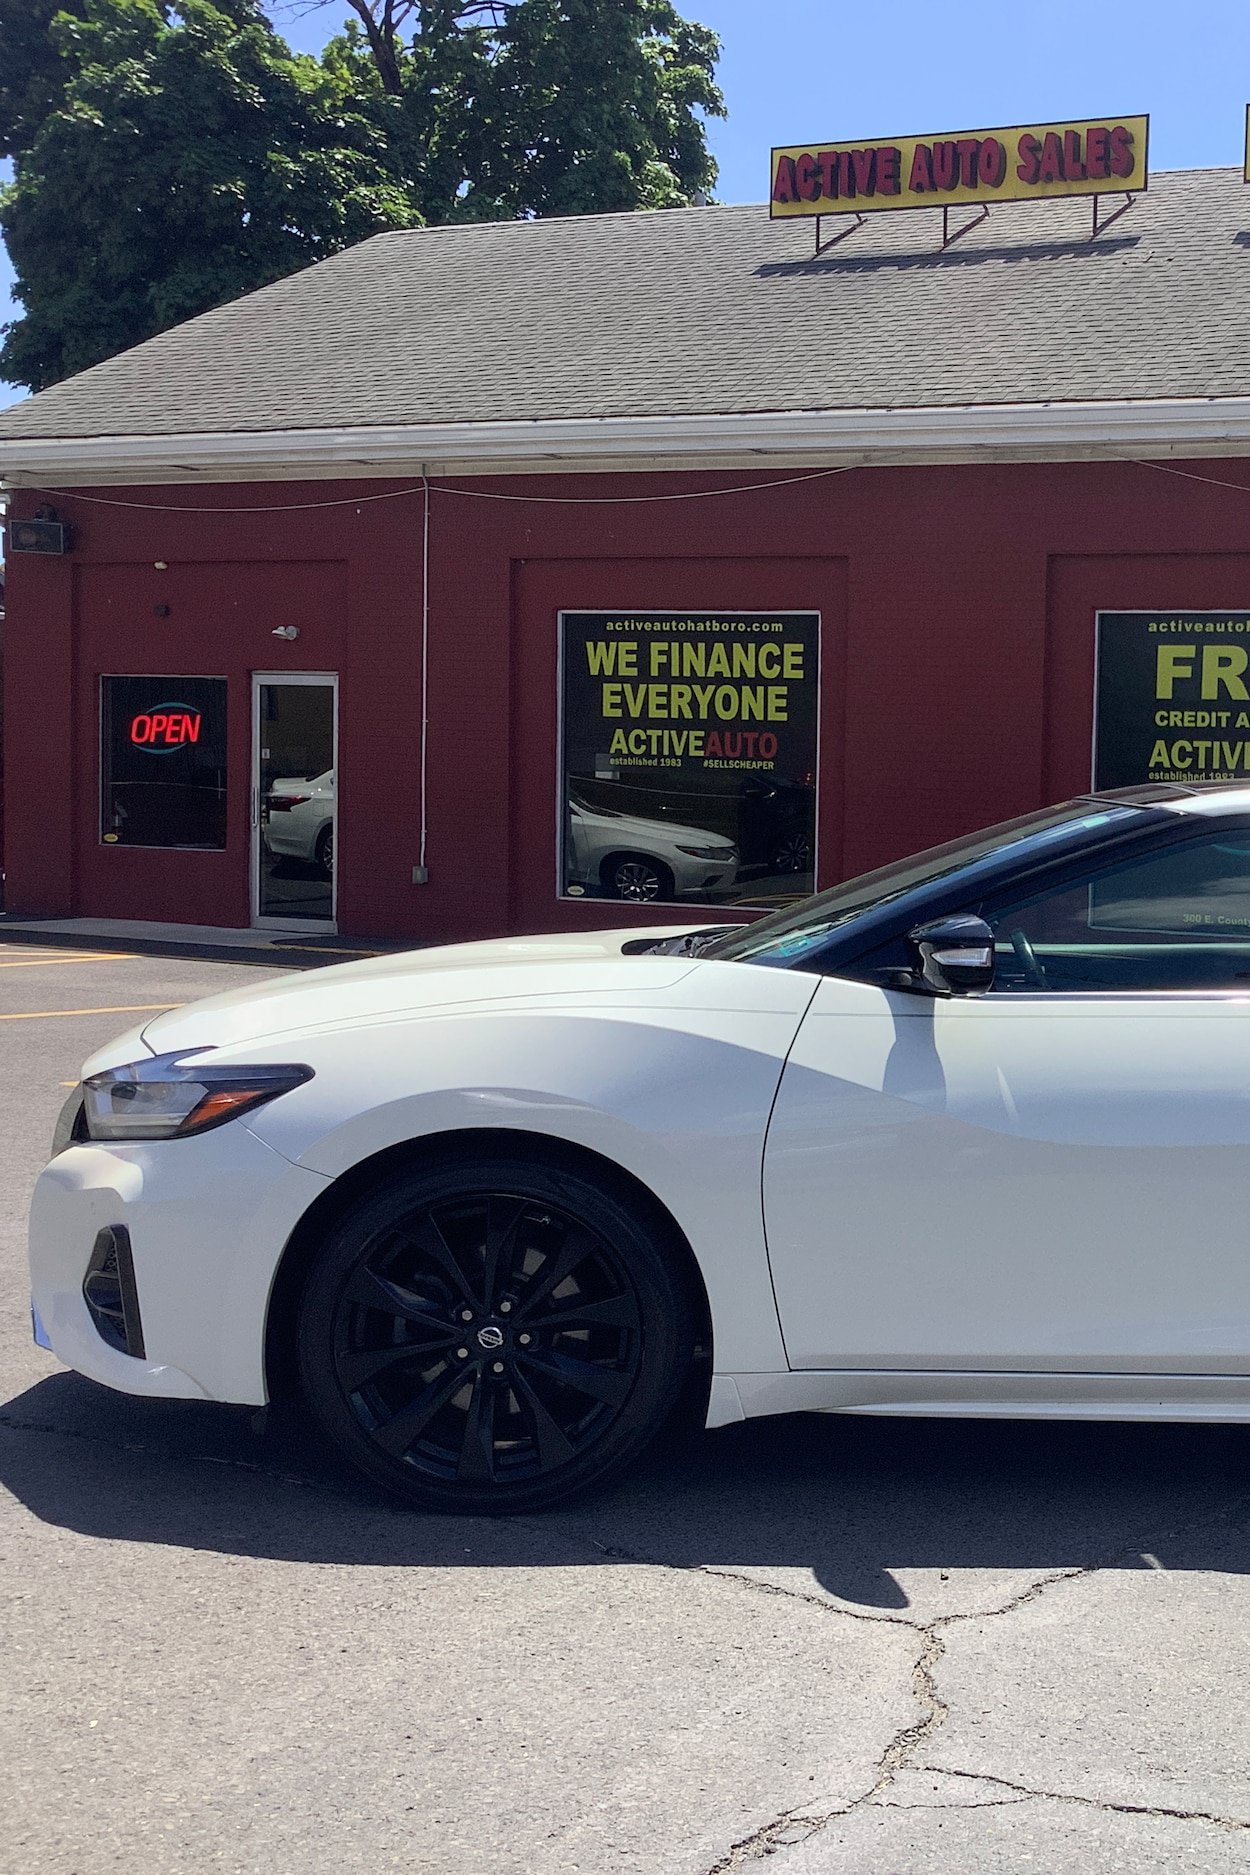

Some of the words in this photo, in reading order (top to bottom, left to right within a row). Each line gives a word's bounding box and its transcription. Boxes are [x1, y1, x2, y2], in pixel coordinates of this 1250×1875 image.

[773, 147, 901, 203] ACTIVE
[908, 137, 1007, 194] AUTO
[1017, 126, 1135, 185] SALES
[606, 620, 783, 632] activeautohatboro.com
[586, 642, 638, 676] WE
[651, 642, 804, 679] FINANCE
[602, 683, 788, 721] EVERYONE
[1154, 711, 1231, 728] CREDIT
[130, 714, 201, 743] OPEN
[610, 757, 657, 766] established
[660, 758, 682, 767] 1983
[703, 759, 775, 770] #SELLSCHEAPER
[1148, 771, 1205, 782] established
